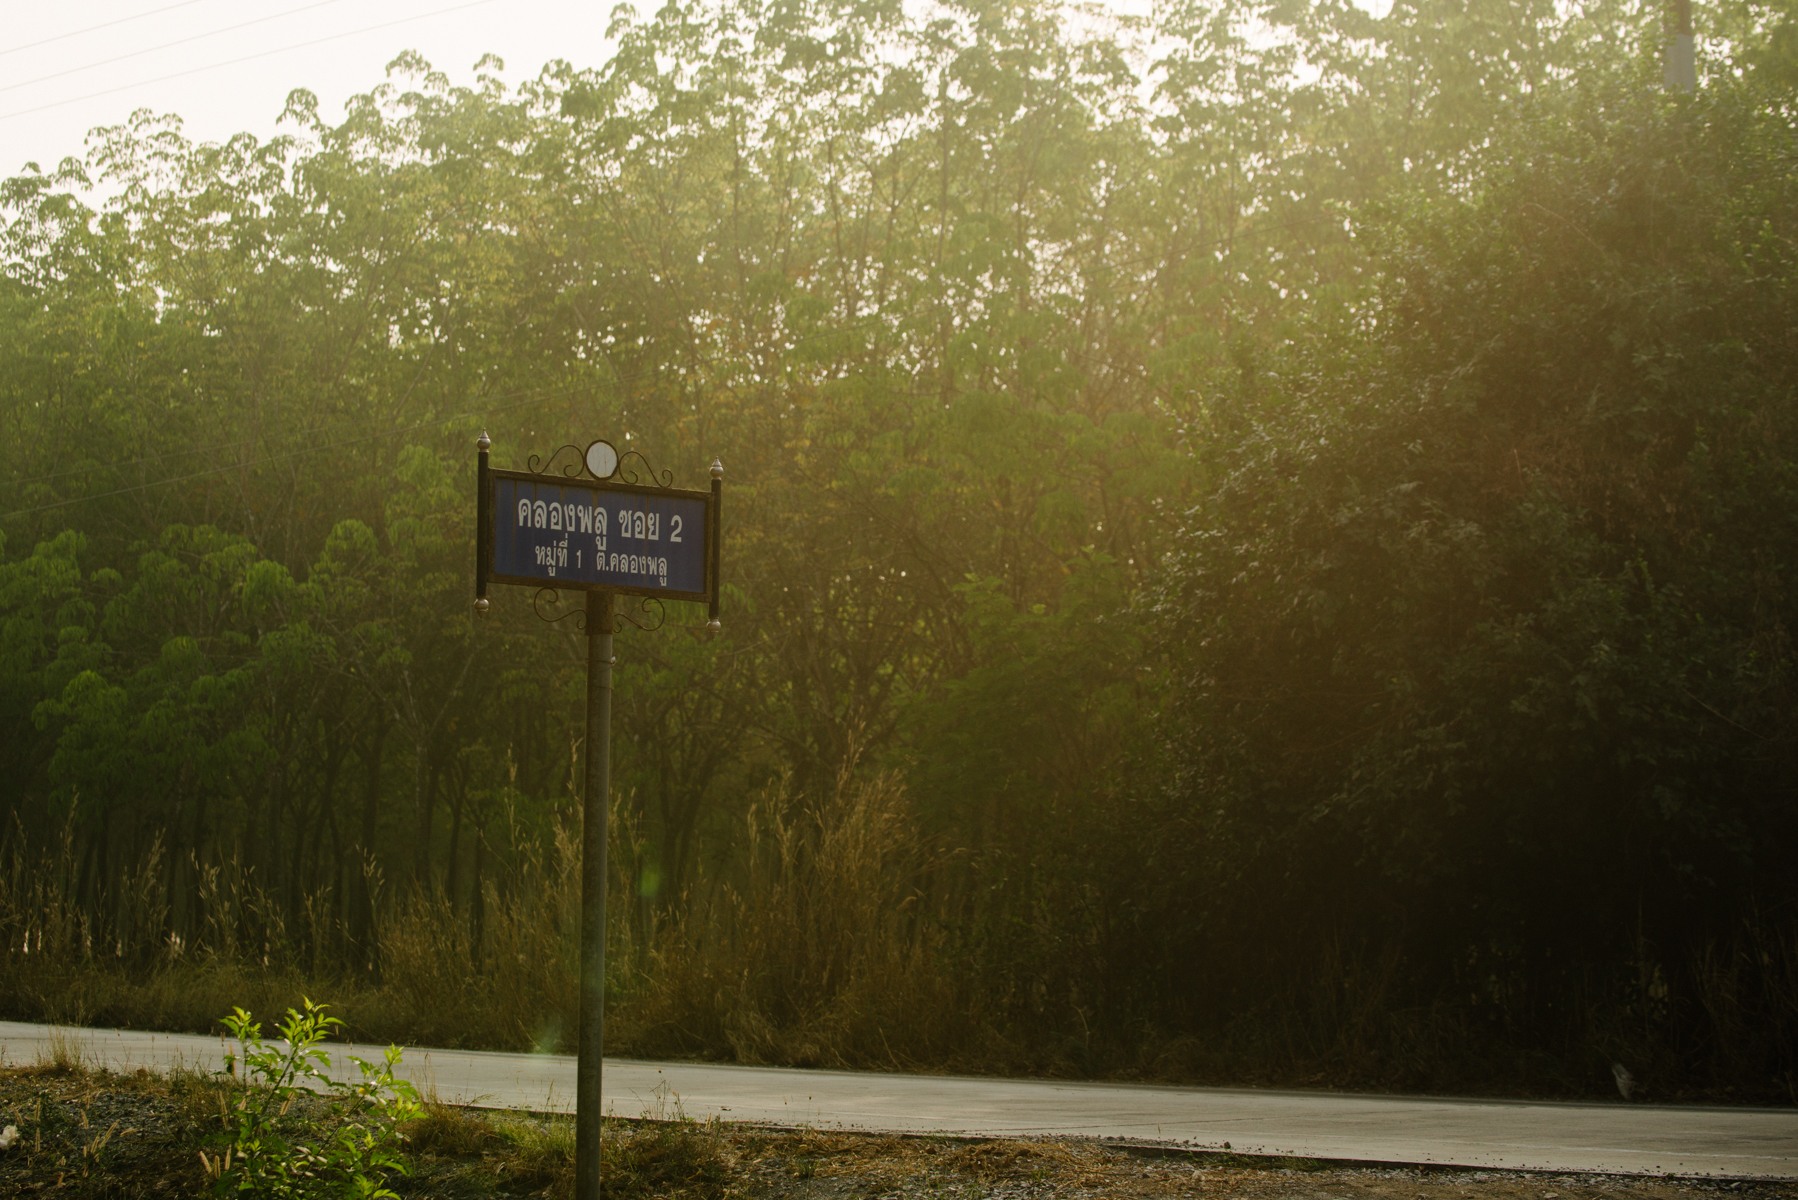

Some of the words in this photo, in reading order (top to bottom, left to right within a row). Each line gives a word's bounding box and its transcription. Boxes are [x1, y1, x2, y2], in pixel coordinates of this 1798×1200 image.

[518, 499, 608, 550] คลองพลู
[619, 509, 660, 541] ซอย
[670, 515, 683, 543] 2
[535, 533, 568, 576] หมู่ที่
[576, 550, 582, 568] 1
[596, 552, 668, 586] ต.คลองพลู
